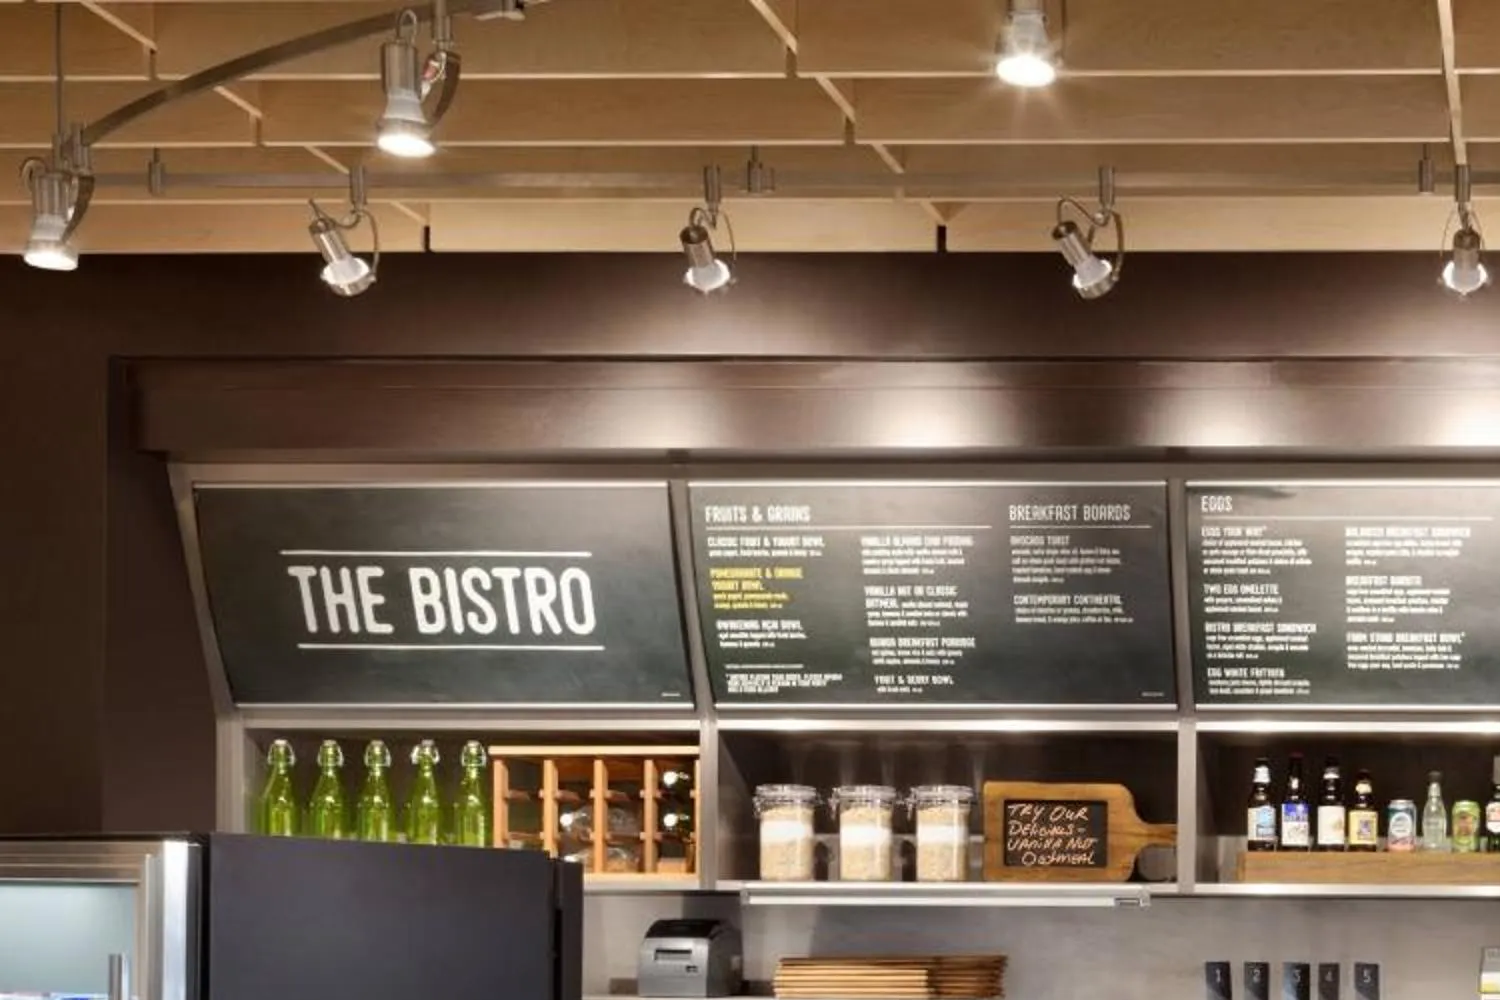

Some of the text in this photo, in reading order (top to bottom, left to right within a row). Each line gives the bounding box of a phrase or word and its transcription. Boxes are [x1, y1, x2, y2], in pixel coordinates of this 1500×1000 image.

[1008, 504, 1131, 522] BREAKFAST BOARDS
[1201, 495, 1233, 514] EGGS
[705, 505, 748, 523] FRUITS
[752, 505, 763, 523] &
[288, 566, 598, 636] THE BISTRO
